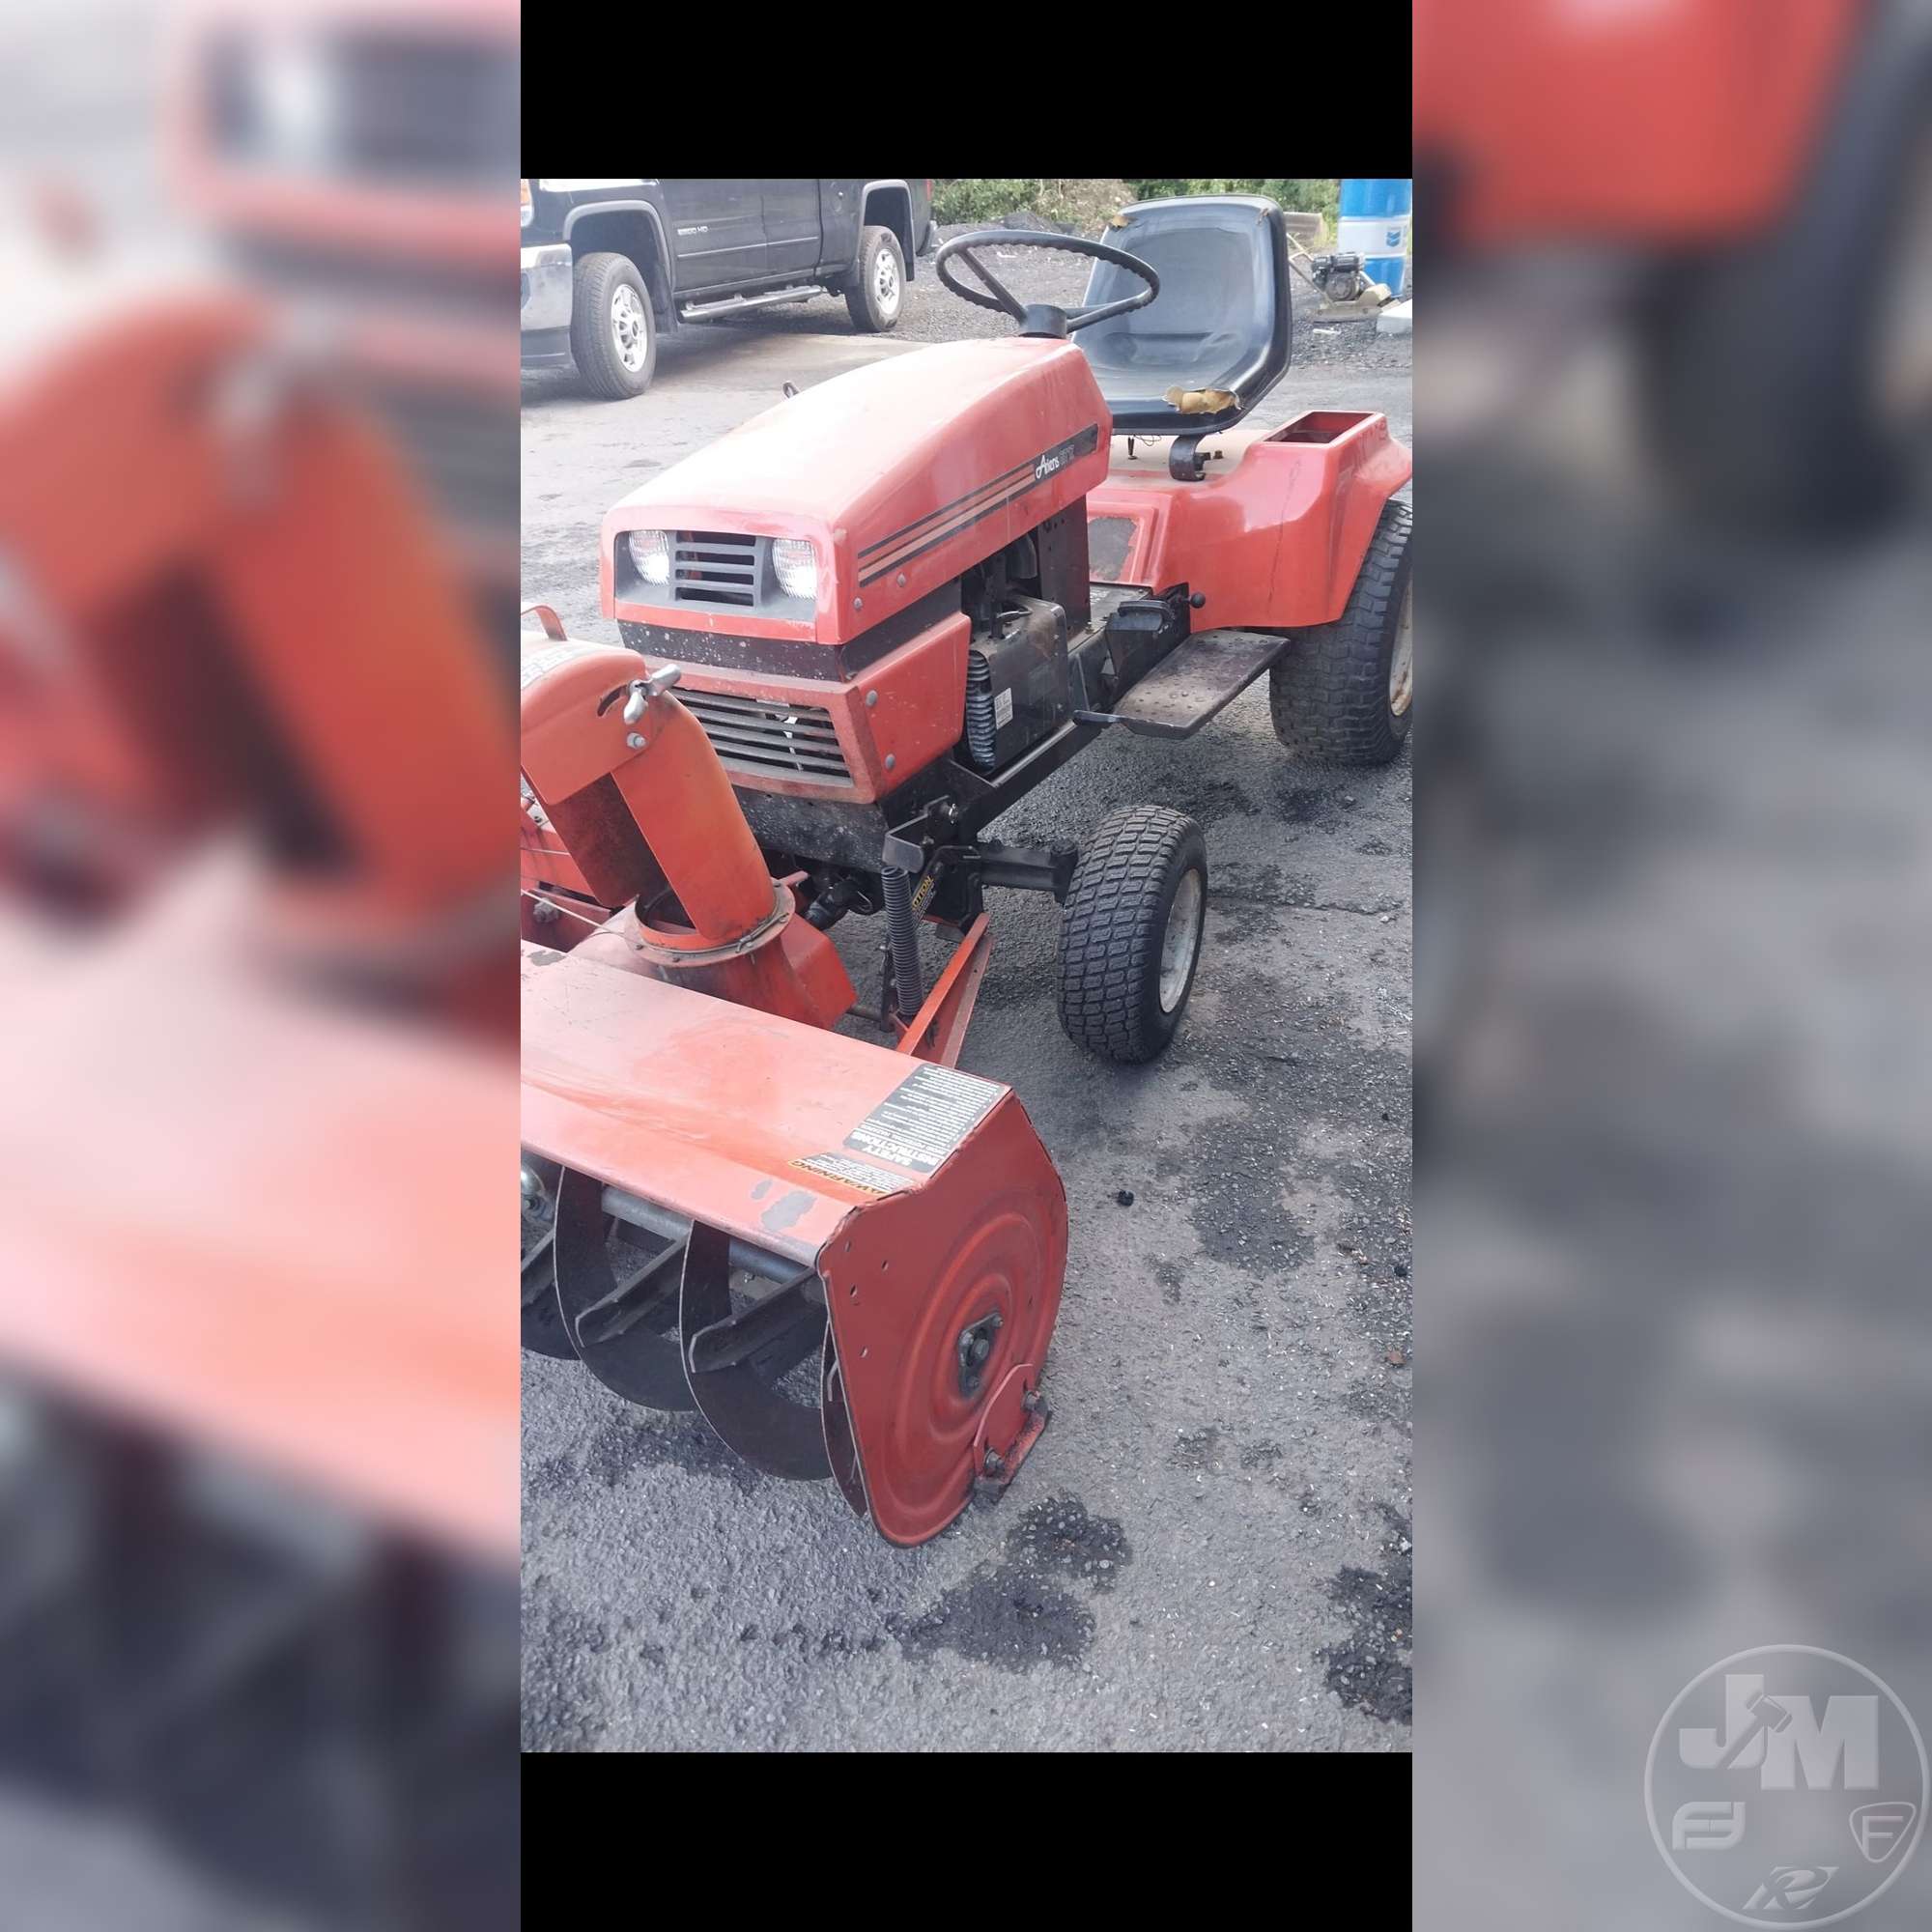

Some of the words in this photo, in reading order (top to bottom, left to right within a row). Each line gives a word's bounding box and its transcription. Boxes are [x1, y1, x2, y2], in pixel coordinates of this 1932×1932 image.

[850, 1131, 940, 1166] INSTRUCTIONS
[862, 1144, 912, 1166] SAFETY
[792, 1161, 869, 1190] WARNING
